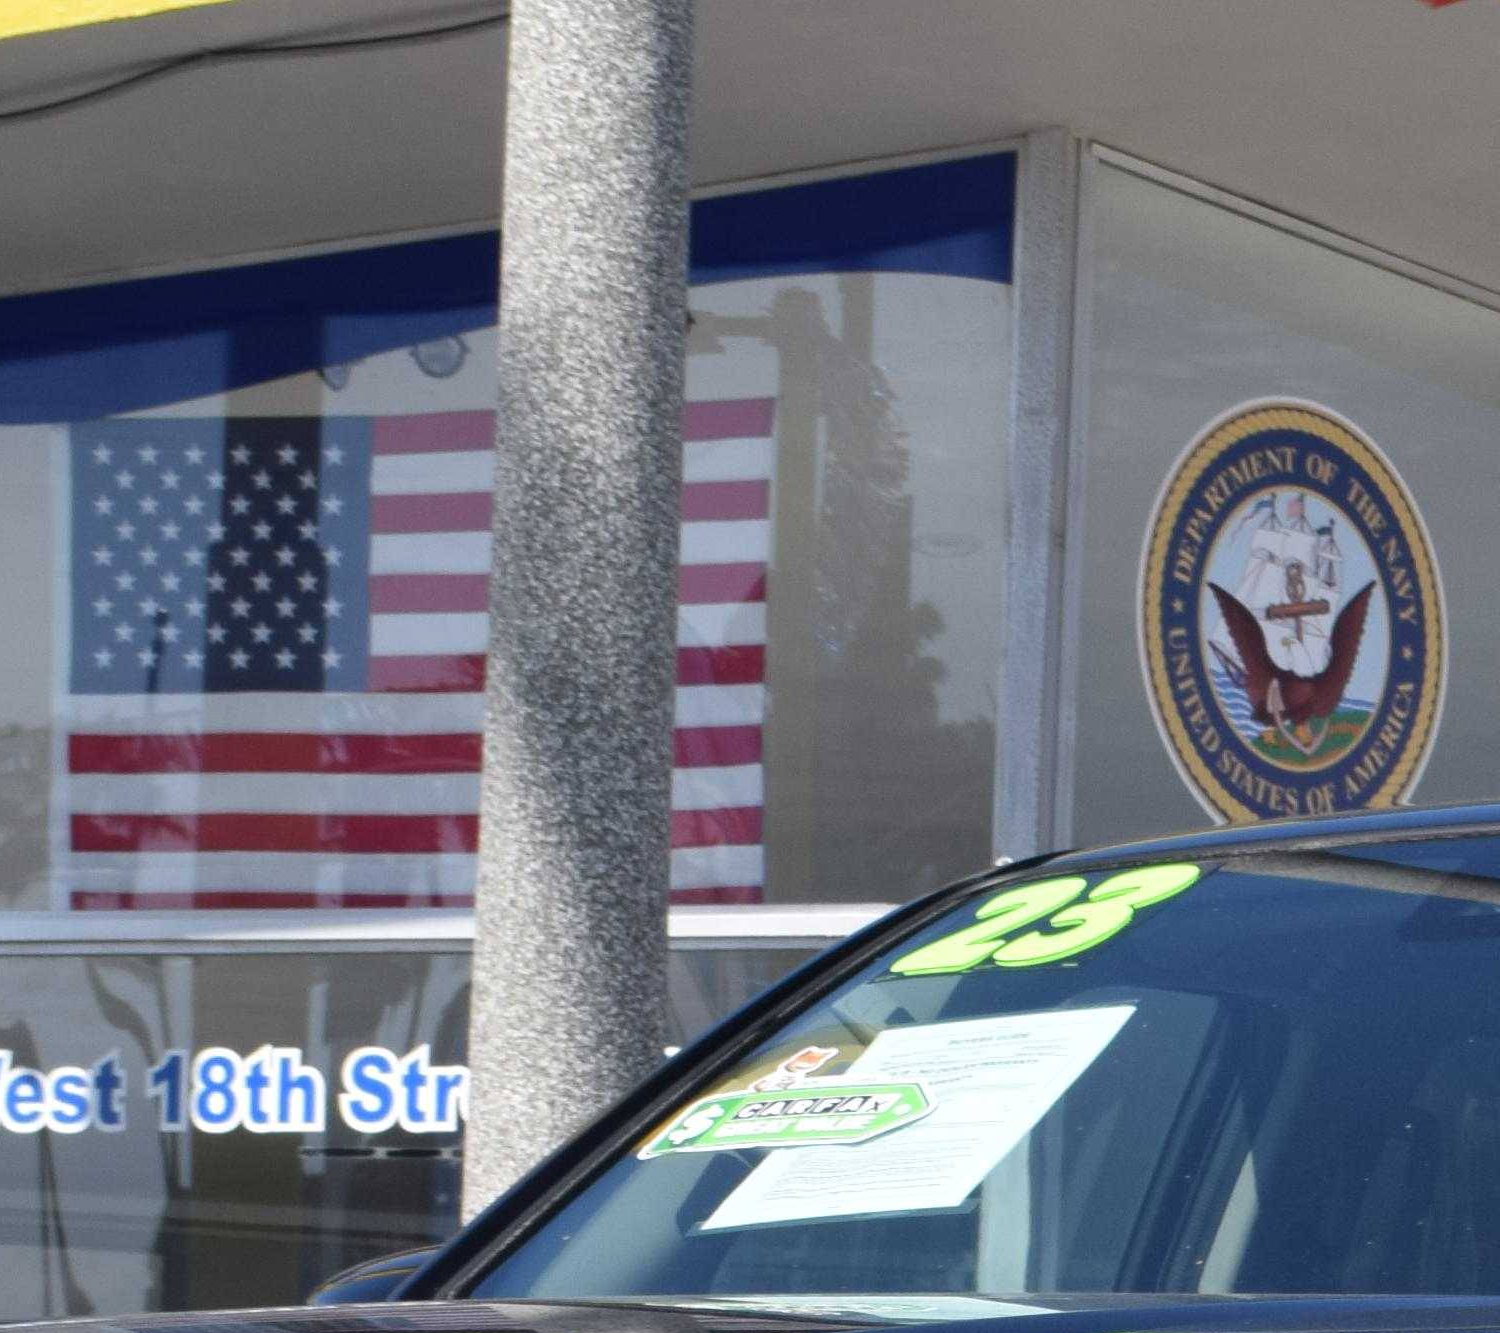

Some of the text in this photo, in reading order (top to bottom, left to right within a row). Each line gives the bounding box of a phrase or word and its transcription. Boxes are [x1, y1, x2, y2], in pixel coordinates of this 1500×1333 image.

[1173, 445, 1419, 626] DEPARTMENT OF THE NAVY
[1168, 627, 1415, 817] UNITED STATES OF AMERICA
[891, 862, 1202, 977] 23
[147, 1045, 326, 1133] 18th
[340, 1044, 471, 1133] Str
[730, 1096, 885, 1121] CARFAX
